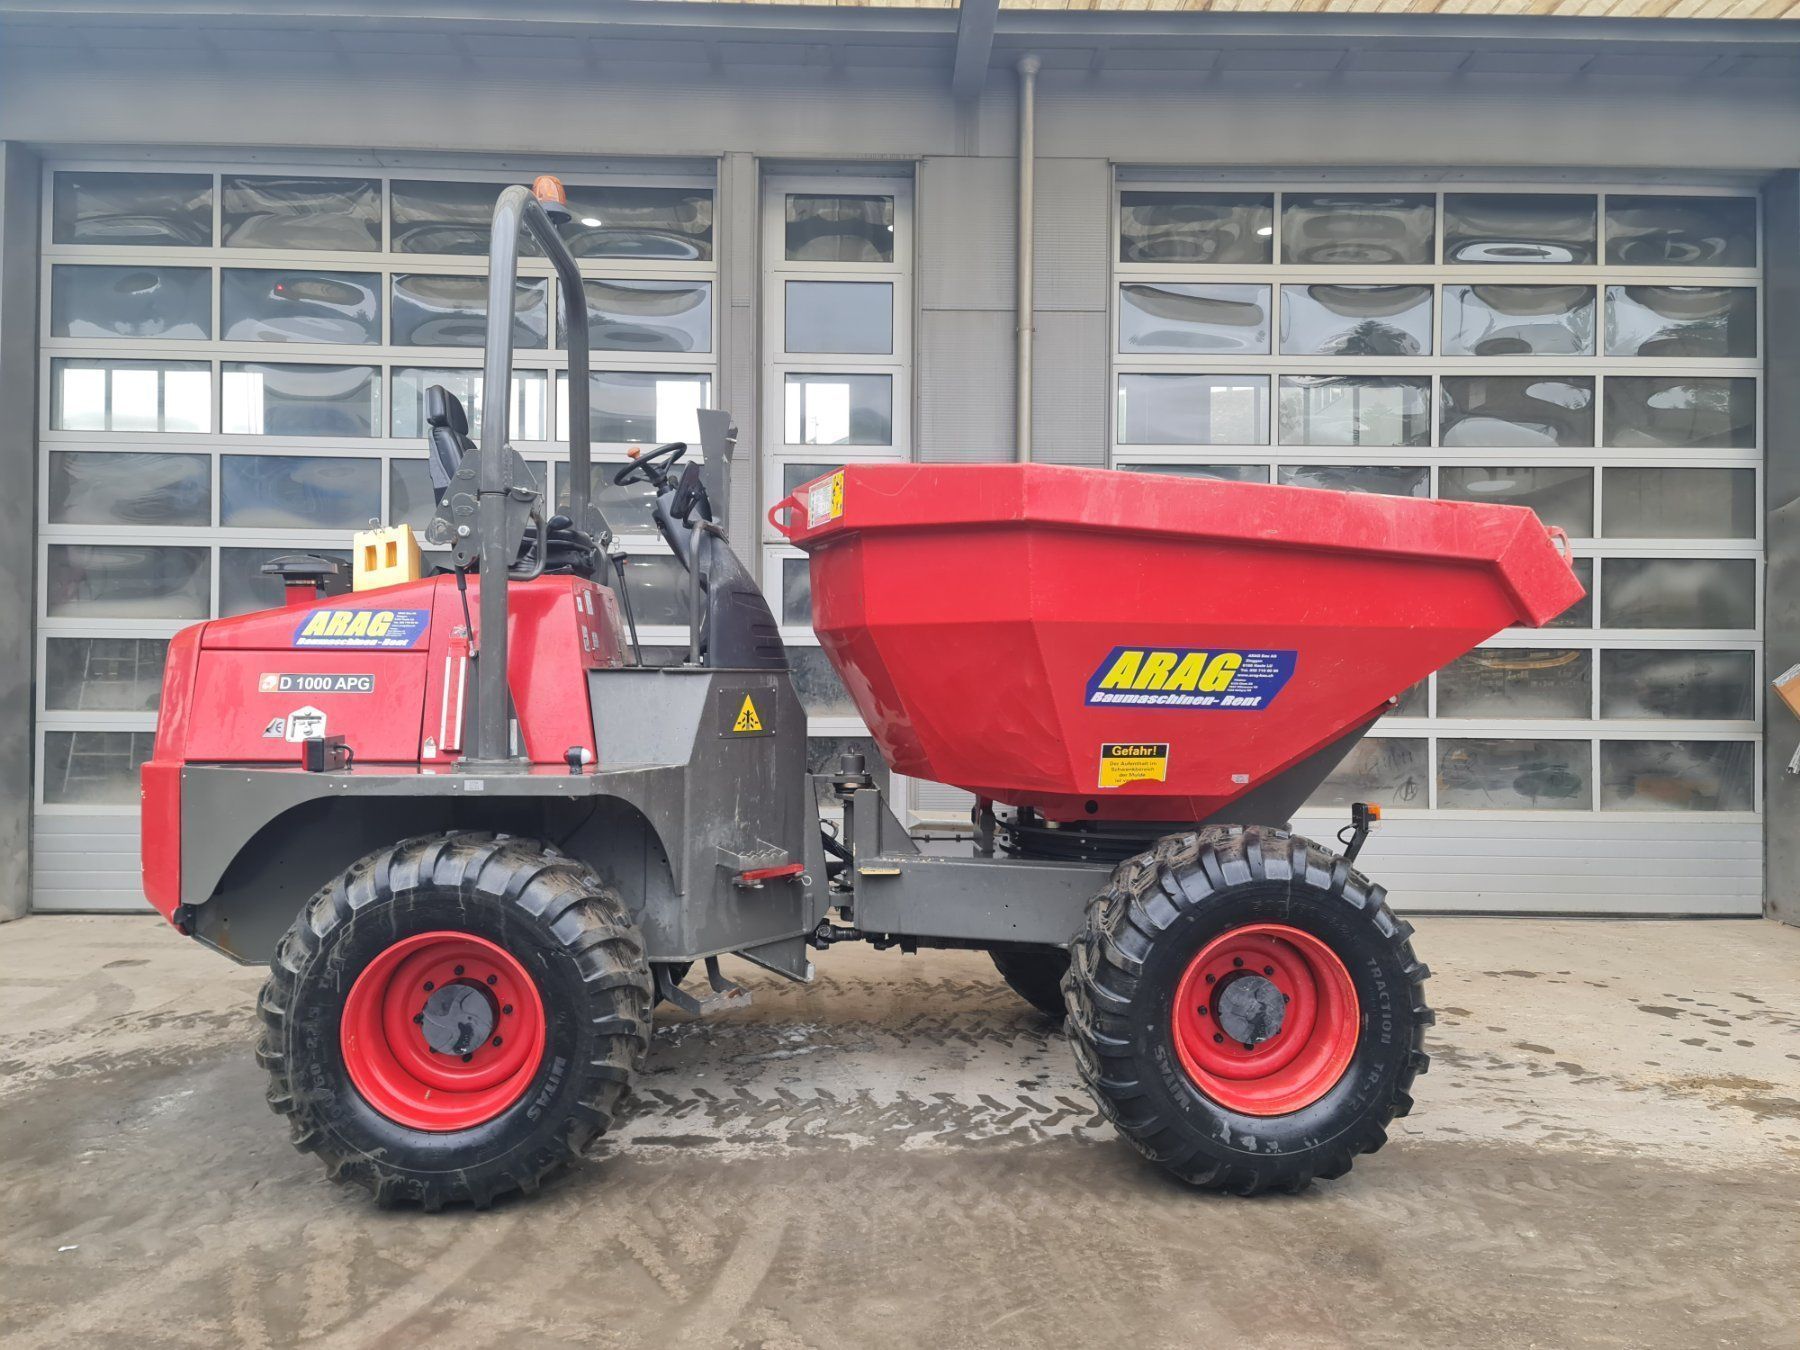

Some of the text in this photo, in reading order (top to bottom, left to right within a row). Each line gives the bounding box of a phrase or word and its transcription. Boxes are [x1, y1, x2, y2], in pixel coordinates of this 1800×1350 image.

[301, 611, 394, 636] ARAG
[280, 677, 370, 690] D 1000 APG
[1098, 651, 1242, 692] ARAG
[1221, 696, 1262, 706] Rent
[1112, 745, 1157, 756] Gefahr!
[1368, 957, 1393, 1045] TRACTION
[526, 1055, 567, 1122] MITAS
[1154, 1044, 1190, 1110] MITAS
